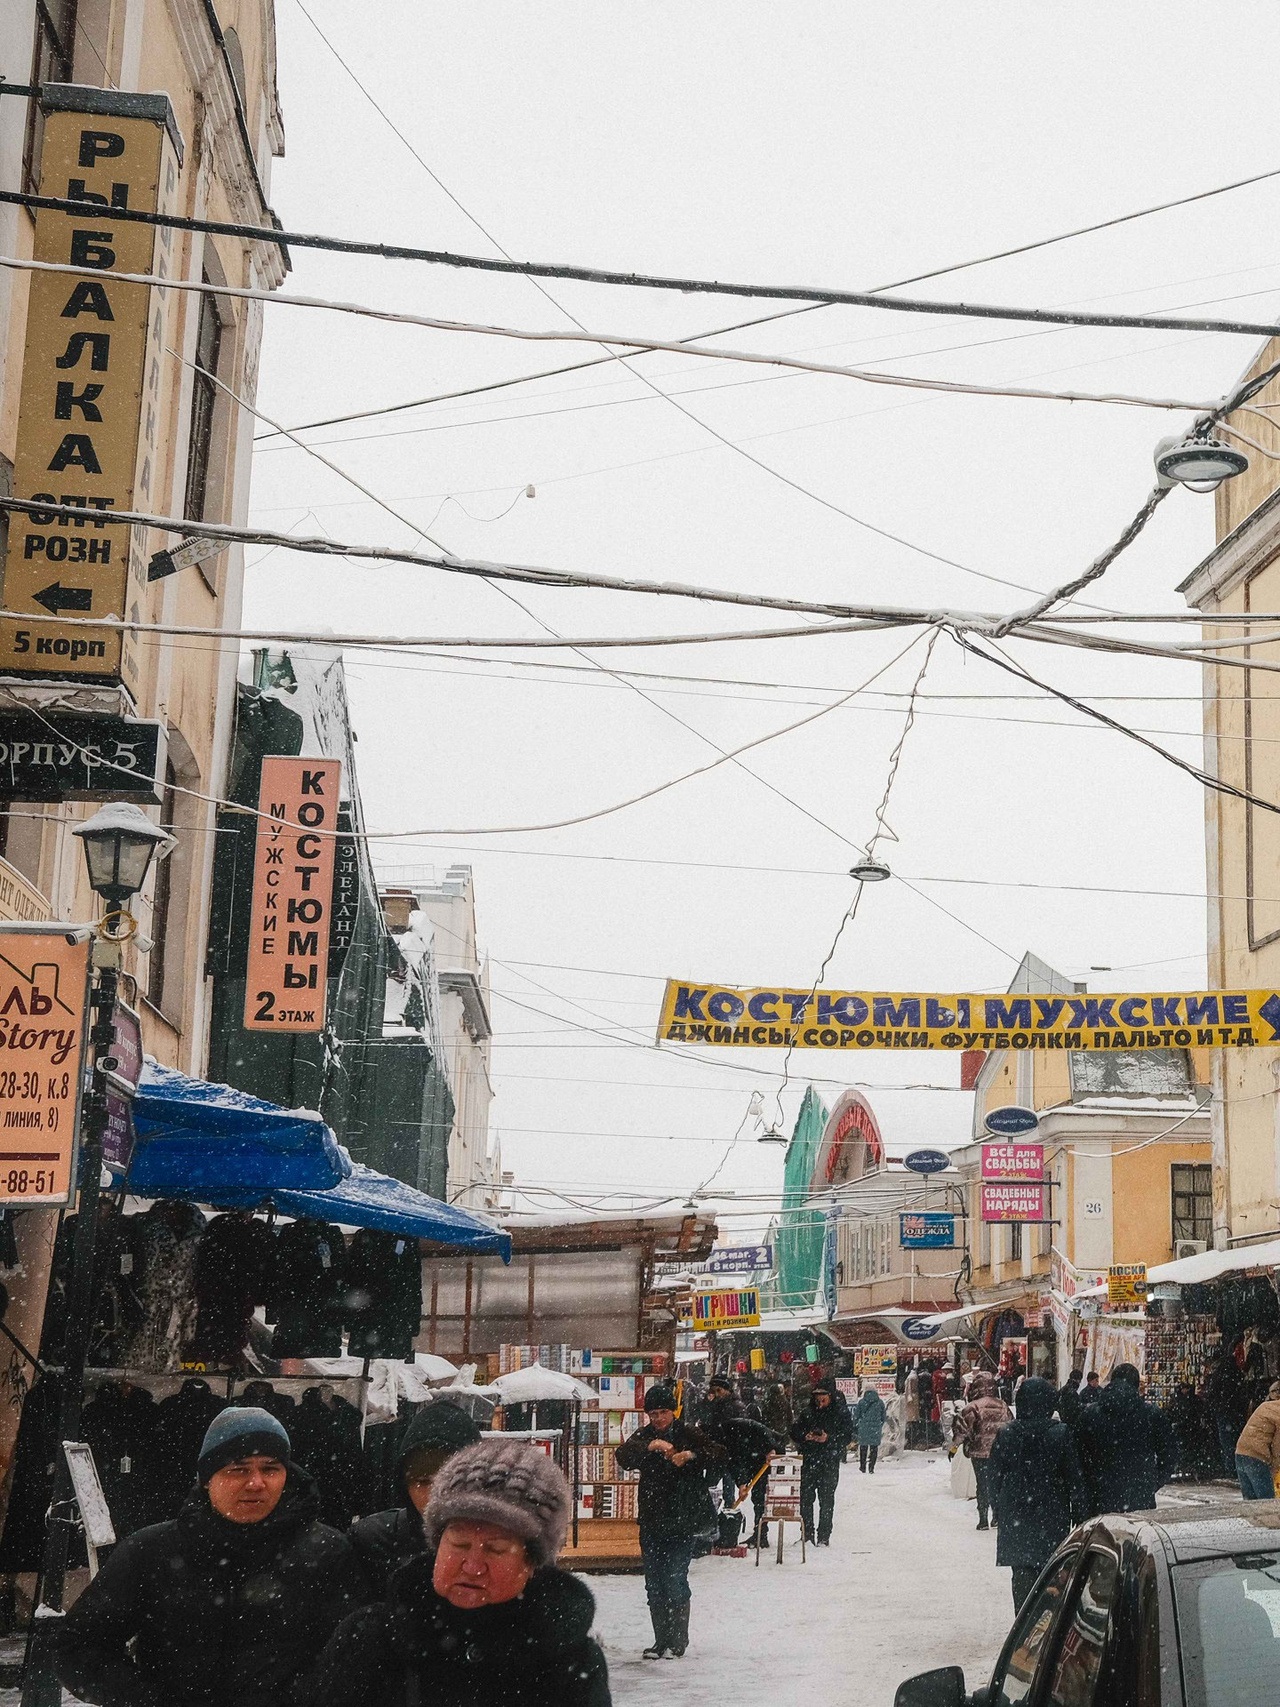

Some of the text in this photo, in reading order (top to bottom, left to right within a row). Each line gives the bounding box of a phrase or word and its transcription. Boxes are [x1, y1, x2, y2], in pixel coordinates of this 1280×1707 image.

[46, 130, 129, 475] РЫБАЛКА
[28, 493, 114, 529] ОПТ
[24, 534, 112, 565] РОЗН
[14, 631, 105, 661] 5 корп
[111, 739, 147, 769] 5
[262, 803, 286, 955] МУЖСКИЕ
[283, 770, 326, 989] КОСТЮМЫ
[335, 845, 355, 948] ЭЛЕГАНТ
[0, 986, 52, 1015] ЛЬ
[254, 991, 315, 1023] 2 ЭТАЖ
[673, 987, 1250, 1030] КОСТЮМЫ МУЖСКИЕ
[803, 1028, 935, 1050] СОРОЧКИ,
[941, 1031, 1088, 1051] ФУТБОЛКИ,
[1093, 1029, 1192, 1049] ПАЛЬТО
[1197, 1030, 1212, 1045] И
[1217, 1028, 1259, 1048] Т.Д.
[985, 1158, 1040, 1171] СВАДЬБЫ
[990, 1146, 1014, 1157] ВСЁ
[984, 1188, 1040, 1199] СВАДЕБНЫЕ
[986, 1200, 1039, 1212] НАРЯДЫ
[1086, 1203, 1101, 1213] 26
[713, 1261, 721, 1270] 8
[722, 1260, 751, 1272] корп.
[755, 1246, 768, 1263] 2
[1109, 1265, 1146, 1276] НОСКИ
[695, 1292, 757, 1319] ИГРУШКИ
[722, 1317, 749, 1327] РОЗНИЦА
